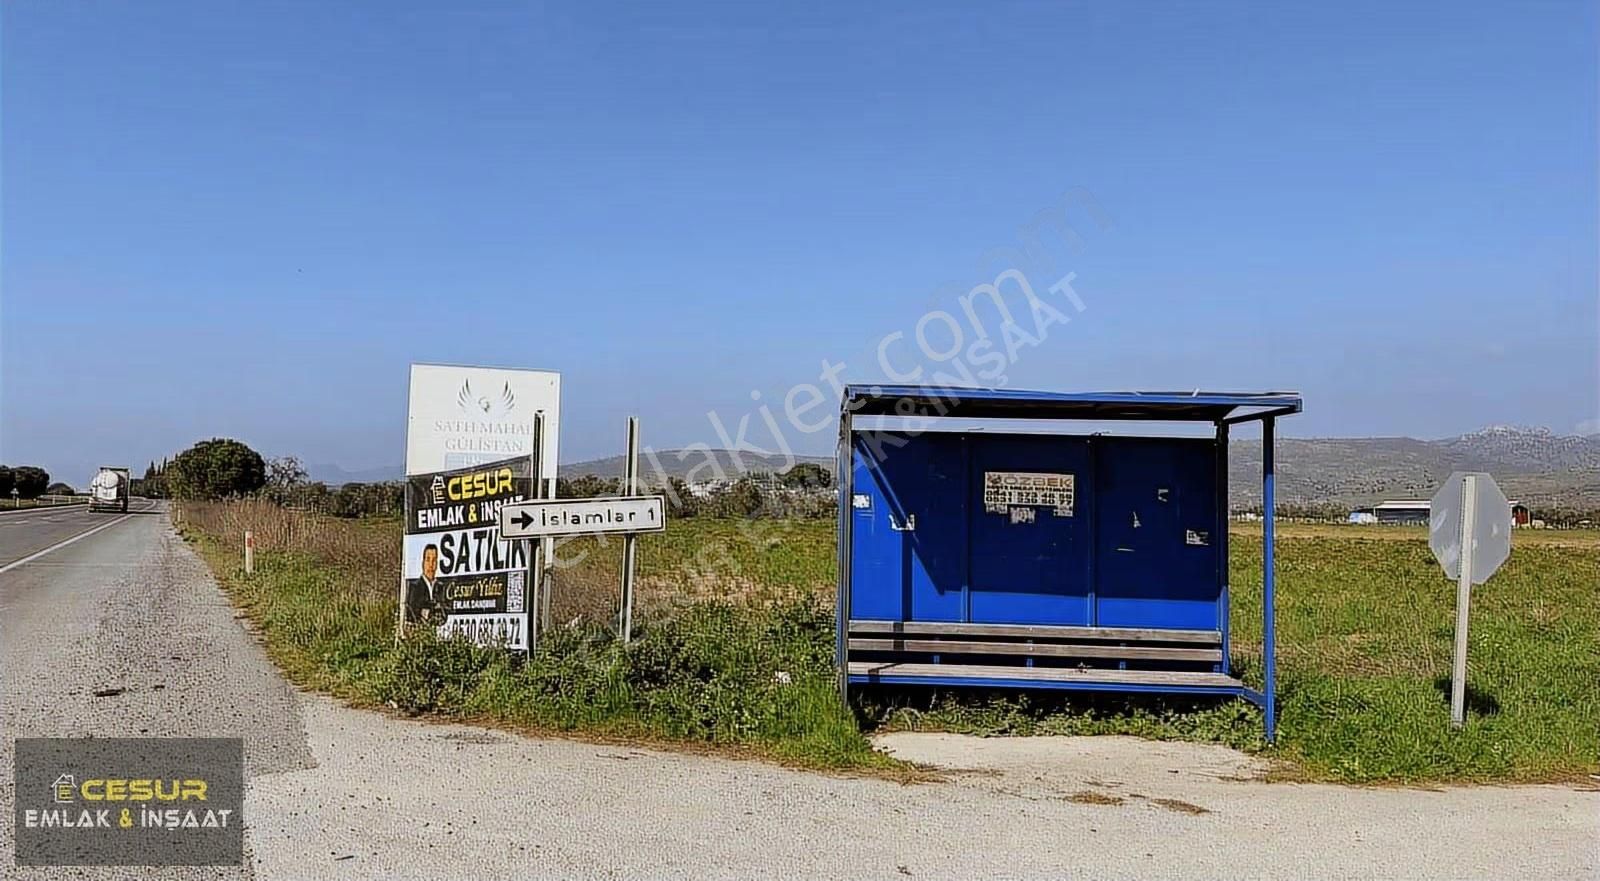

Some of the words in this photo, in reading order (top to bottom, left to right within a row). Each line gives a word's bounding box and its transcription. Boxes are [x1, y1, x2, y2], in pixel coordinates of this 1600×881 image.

[448, 468, 513, 500] CESUR
[418, 505, 464, 528] EMLAK
[468, 503, 478, 523] &
[647, 507, 655, 521] 1
[446, 581, 475, 600] Cesur
[509, 617, 521, 645] 72
